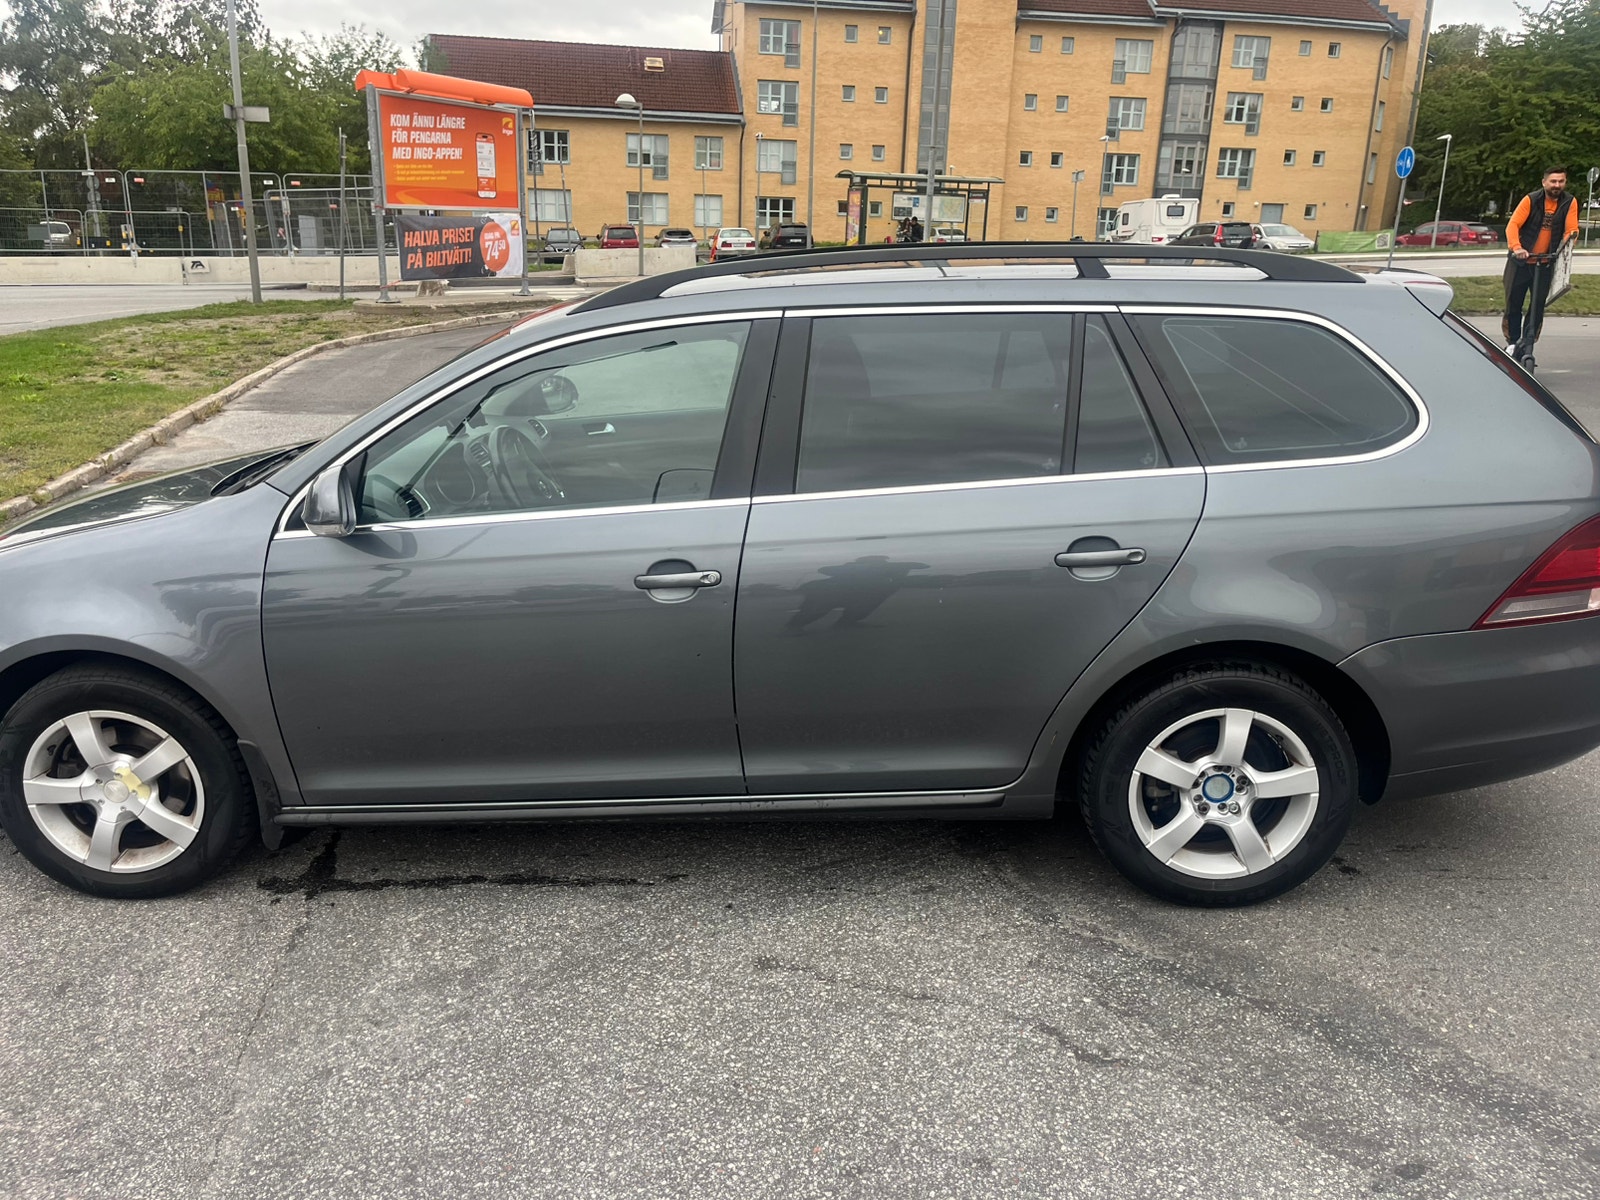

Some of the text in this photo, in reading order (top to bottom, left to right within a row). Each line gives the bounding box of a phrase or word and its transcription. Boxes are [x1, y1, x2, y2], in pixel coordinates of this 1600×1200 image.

[390, 112, 466, 129] KOM ÄNNU LÄNGRE
[391, 128, 452, 144] FÖR PENGARNA
[392, 147, 463, 160] MED INGO-APPEN!
[404, 229, 440, 248] HALVA
[442, 226, 475, 244] PRISET
[406, 245, 472, 269] PÅ BILTVÄTT!
